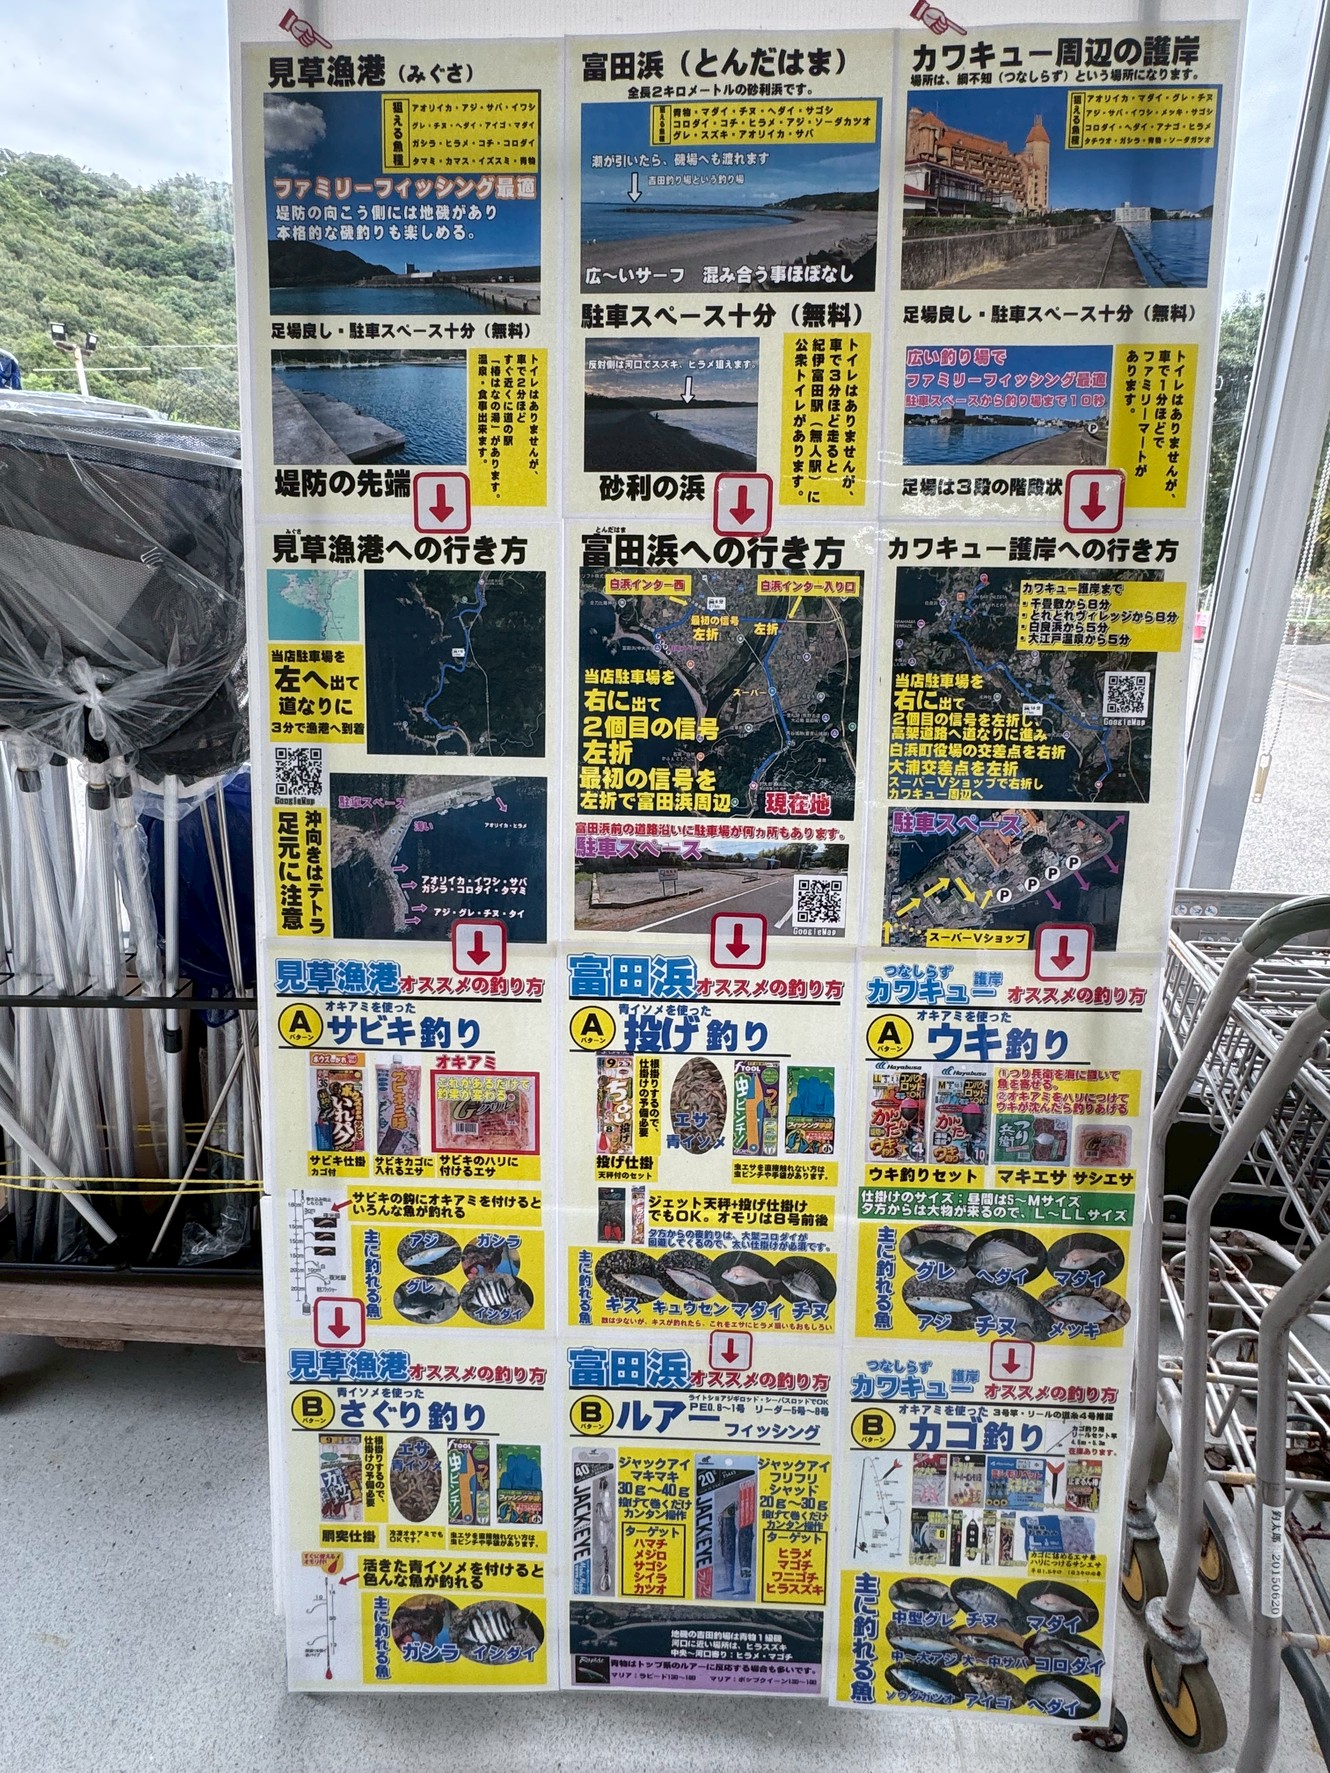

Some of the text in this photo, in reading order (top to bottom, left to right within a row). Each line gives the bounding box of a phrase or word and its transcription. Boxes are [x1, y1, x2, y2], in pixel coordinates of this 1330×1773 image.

[914, 36, 1200, 71] カワキュー周辺の護岸
[268, 55, 473, 88] 見草漁港（みぐさ）
[582, 48, 846, 81] 富田浜（とんだはま）
[628, 83, 813, 98] 全長2キロメートルの砂利浜です。
[1087, 94, 1213, 102] アオリイカ・マダイ・グレ・チヌ
[412, 103, 536, 112] アオリイカ・アジ・サバ・イワシ
[673, 106, 834, 117] 青物・マダイ・チヌ・ヘダイ・サゴシ
[673, 129, 814, 141] グレ・スズキ・アオリイカ・サバ
[412, 138, 535, 148] ガシラ・ヒラメ・コチ・コロダイ
[591, 151, 769, 168] 潮が引いたら、磯場へも渡れます
[273, 176, 536, 199] ファミリーフィッシング最適
[275, 205, 497, 221] 堤防の向こう側には地磯があり
[276, 225, 475, 241] 本格的な磯釣りも楽しめる。
[703, 265, 854, 283] 混み合う事ほぼなし
[582, 303, 862, 328] 駐車スペース十分（無料）
[271, 323, 530, 339] 足場良し・駐車スペース十分（無料）
[907, 348, 1006, 367] 広い釣り場で
[906, 371, 1107, 389] ファミリーフィッシング最適
[1125, 351, 1139, 414] あります。
[516, 354, 526, 423] 車で2分ほど
[503, 354, 513, 446] すぐ近くに道の駅
[826, 338, 843, 473] 車で3分ほど走ると
[1153, 351, 1171, 448] 車で1分ほどで
[478, 354, 487, 464] 温泉・食事出来ます。
[528, 354, 539, 475] トイレはありませんが、
[1135, 351, 1155, 477] ファミリーマートが
[792, 338, 808, 496] 公衆トイレがあります。
[275, 469, 411, 498] 堤防の先端
[599, 475, 705, 501] 砂利の浜
[903, 478, 1062, 496] 足場は3段の階段状
[273, 535, 528, 564] 見草漁港への行き方
[581, 534, 845, 568] 富田浜への行き方
[889, 536, 1179, 562] カワキュー護岸への行き方
[610, 579, 685, 591] 白浜インター西
[1022, 583, 1123, 595] カワキュー護岸まで
[691, 615, 739, 626] 最初の信号
[693, 629, 718, 641] 左折
[272, 650, 345, 663] 当店駐車場を
[584, 669, 675, 685] 当店駐車場を
[279, 697, 352, 715] 道なりに
[272, 722, 364, 735] 3分で漁港へ到着
[582, 716, 719, 741] 2個目の信号
[889, 761, 1018, 776] 大浦交差点を左折
[579, 769, 716, 791] 最初の信号を
[339, 796, 406, 809] 駐車スペース
[765, 792, 831, 815] 現在地
[893, 812, 1022, 836] 駐車スペース
[575, 837, 702, 860] 駐車スペース
[1070, 857, 1077, 868] P
[278, 812, 303, 930] 足元に注意
[306, 810, 325, 934] 沖向きはテトラ
[1049, 869, 1056, 879] P
[422, 876, 527, 886] アオリイカ・イワシ・サバ
[1029, 880, 1036, 890] P
[422, 885, 527, 895] ガシラ・コロダイ・タマミ
[1001, 890, 1008, 901] P
[434, 908, 525, 918] アジ・グレ・チヌ・タイ
[274, 958, 543, 996] 見草漁港 オススメの釣り方
[567, 952, 844, 999] 富田浜 オススメの釣り方
[884, 964, 954, 979] つなしらず
[326, 1002, 416, 1013] オキアミを使った
[619, 1004, 711, 1016] 青イソメを使った
[290, 1011, 311, 1032] A
[917, 1011, 1011, 1023] オキアミを使った
[327, 1015, 480, 1048] サビキ釣り
[624, 1014, 768, 1053] 投げ釣り
[928, 1022, 1068, 1061] ウキ釣り
[436, 1055, 496, 1070] オキアミ
[674, 1111, 709, 1128] エサ
[666, 1134, 725, 1149] 青イソメ
[310, 1156, 365, 1167] サビキ仕掛
[375, 1156, 432, 1167] サビキカゴに
[439, 1155, 518, 1167] サビキのハリに
[596, 1155, 654, 1170] 投げ仕掛
[311, 1168, 336, 1176] カゴ付
[375, 1167, 423, 1175] 入れるエサ
[439, 1166, 496, 1176] 付けるエサ
[869, 1168, 976, 1183] ウキ釣りセット
[998, 1169, 1066, 1184] マキエサ
[1072, 1172, 1133, 1185] サシエサ
[354, 1205, 465, 1218] いろんな魚が釣れる
[409, 1234, 439, 1247] アジ
[477, 1234, 522, 1247] ガシラ
[364, 1229, 381, 1319] 主に釣れる魚
[976, 1268, 1028, 1284] ヘダイ
[407, 1280, 435, 1293] グレ
[578, 1250, 592, 1324] 主に釣れる魚
[605, 1297, 640, 1312] キス
[653, 1302, 728, 1316] キュウセン
[731, 1303, 784, 1318] マダイ
[792, 1304, 828, 1320] チヌ
[475, 1307, 523, 1320] イシダイ
[975, 1317, 1016, 1336] チヌ
[289, 1349, 410, 1382] 見草漁港
[567, 1347, 690, 1388] 富田浜
[337, 1388, 424, 1399] 青イソメを使った
[302, 1396, 322, 1416] B
[581, 1402, 602, 1421] B
[341, 1399, 485, 1430] さぐり釣り
[617, 1400, 820, 1440] ルアー フィッシング
[908, 1417, 1043, 1452] カゴ釣り
[398, 1442, 431, 1456] エサ
[619, 1457, 690, 1468] ジャックアイ
[631, 1471, 678, 1482] マキマキ
[618, 1498, 691, 1509] 投げて巻くだけ
[625, 1526, 679, 1537] ターゲット
[634, 1540, 667, 1549] ハマチ
[635, 1550, 666, 1560] メジロ
[778, 1548, 811, 1558] ヒラメ
[634, 1561, 667, 1571] サゴシ
[779, 1559, 812, 1570] マゴチ
[364, 1573, 483, 1589] 色んな魚が釣れる
[634, 1573, 667, 1582] シイラ
[772, 1572, 818, 1582] ワニゴチ
[634, 1584, 665, 1594] カツオ
[766, 1583, 823, 1595] ヒラスズキ
[402, 1645, 461, 1661] ガシラ
[1035, 1657, 1105, 1677] コロダイ
